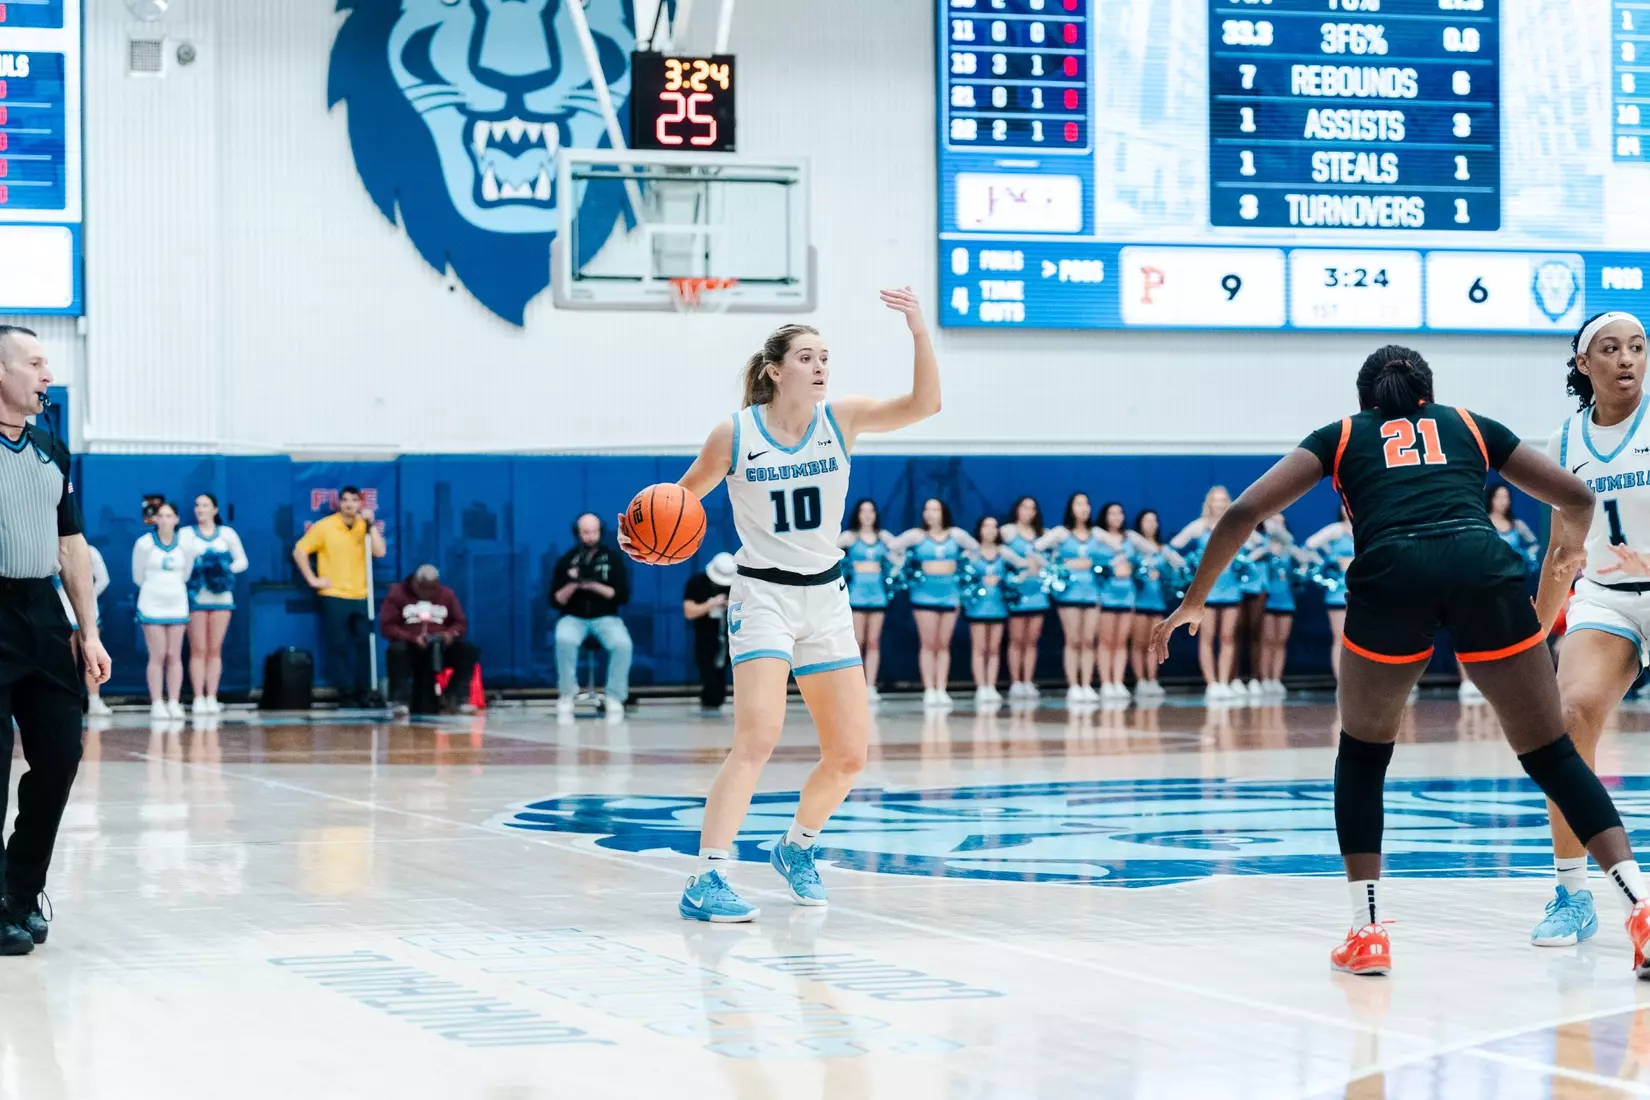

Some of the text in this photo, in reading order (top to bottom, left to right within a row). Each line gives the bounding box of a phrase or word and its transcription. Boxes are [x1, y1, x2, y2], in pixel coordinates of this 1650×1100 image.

[991, 20, 1007, 42] 0
[1030, 21, 1045, 43] 0
[1063, 23, 1078, 44] 0
[1443, 27, 1481, 52] 0.0
[665, 58, 730, 92] 3:24
[991, 53, 1007, 75] 3
[1031, 54, 1044, 76] 1
[1063, 56, 1079, 77] 0
[1239, 64, 1471, 98] 7 REBOUNDS 6
[991, 86, 1007, 108] 0
[1031, 87, 1044, 109] 1
[1063, 89, 1079, 109] 0
[656, 91, 717, 146] 25
[992, 119, 1007, 141] 2
[1031, 120, 1044, 141] 1
[1240, 107, 1256, 132] 1
[1303, 108, 1405, 141] ASSISTS
[1240, 150, 1470, 183] 1 STEALS 1
[1284, 194, 1425, 227] TURNOVERS
[1454, 198, 1470, 223] 1
[1140, 266, 1243, 305] P 9
[1324, 268, 1391, 288] 3:24
[1468, 277, 1489, 304] 6
[1380, 417, 1448, 469] 21
[746, 457, 839, 482] COLUMBIA
[1586, 470, 1650, 494] LUMBI
[769, 486, 822, 534] 10
[1602, 499, 1629, 547] 1
[731, 952, 1007, 1002] COURT
[292, 965, 618, 1048] JONATHAN
